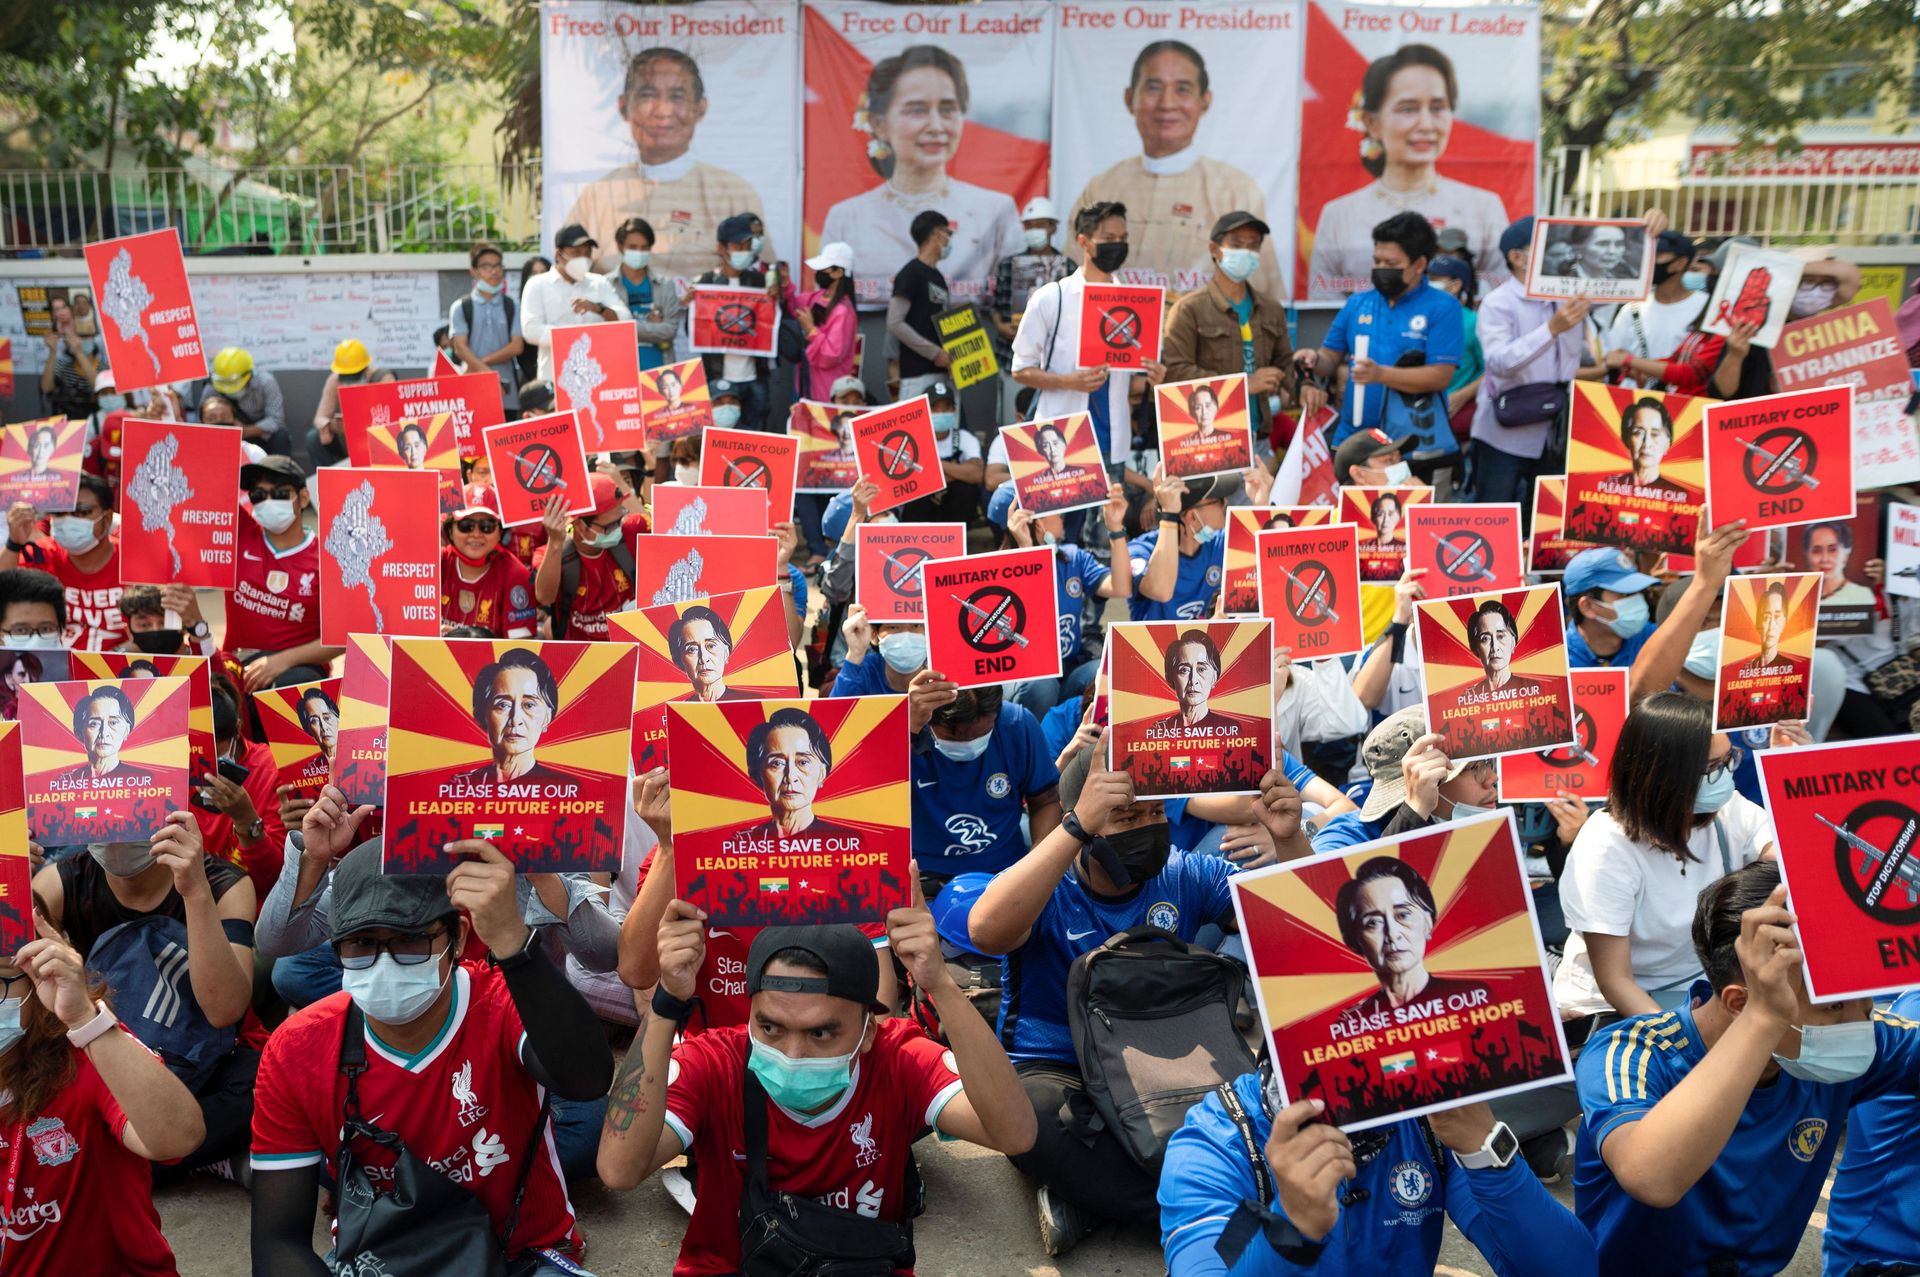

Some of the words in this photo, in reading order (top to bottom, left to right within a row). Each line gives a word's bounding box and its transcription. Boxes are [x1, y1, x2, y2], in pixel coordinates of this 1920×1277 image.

[551, 14, 604, 35] Free
[616, 15, 660, 35] Our
[671, 14, 785, 35] President
[843, 12, 896, 34] Free
[905, 12, 948, 34] Our
[959, 13, 1042, 34] Leader
[1061, 8, 1124, 30] Free
[1136, 8, 1173, 29] Our
[1180, 9, 1292, 30] President
[1344, 11, 1391, 32] Free
[1400, 11, 1441, 33] Our
[1450, 12, 1527, 35] Leader
[1089, 294, 1128, 303] MILITARY
[1130, 296, 1157, 304] COUP
[149, 306, 192, 326] #RESPECT
[177, 325, 196, 340] OUR
[1784, 311, 1880, 357] CHINA
[172, 341, 200, 359] VOTES
[951, 335, 986, 361] MILITARY
[1105, 352, 1132, 363] END
[1779, 336, 1900, 386] TYRANNIZE
[397, 382, 439, 399] SUPPORT
[600, 387, 638, 401] #RESPECT
[404, 398, 466, 417] MYANMAR
[623, 403, 640, 415] OUR
[616, 418, 641, 431] VOTES
[859, 418, 897, 438] MILITARY
[899, 409, 923, 425] COUP
[1719, 410, 1792, 431] MILITARY
[1794, 402, 1840, 420] COUP
[494, 429, 538, 448] MILITARY
[540, 424, 569, 438] COUP
[1202, 436, 1217, 444] SAVE
[712, 439, 757, 453] MILITARY
[761, 445, 790, 455] COUP
[1055, 471, 1070, 480] SAVE
[893, 480, 918, 498] END
[1024, 483, 1050, 493] LEADER
[1597, 480, 1633, 495] PLEASE
[1634, 484, 1663, 498] SAVE
[1664, 490, 1687, 503] OUR
[1579, 490, 1620, 506] LEADER
[1625, 496, 1668, 512] FUTURE
[1759, 497, 1804, 518] END
[182, 509, 234, 526] #RESPECT
[1418, 516, 1470, 527] MILITARY
[1474, 517, 1510, 527] COUP
[212, 531, 233, 545] OUR
[867, 535, 917, 544] MILITARY
[922, 535, 955, 544] COUP
[201, 550, 232, 564] VOTES
[1267, 543, 1316, 558] MILITARY
[1319, 541, 1349, 554] COUP
[382, 562, 435, 578] #RESPECT
[935, 570, 998, 587] MILITARY
[1002, 563, 1043, 579] COUP
[1233, 579, 1258, 588] LEADE
[64, 587, 124, 608] EVER
[238, 581, 289, 610] Standard
[414, 585, 436, 600] OUR
[233, 591, 286, 620] Chartered
[402, 605, 436, 620] VOTES
[973, 629, 985, 643] STOP
[984, 595, 1012, 631] DICTATORSHIP
[1298, 631, 1330, 648] END
[975, 655, 1016, 675] END
[1739, 667, 1761, 679] PLEASE
[1761, 665, 1777, 677] SAVE
[1779, 664, 1793, 675] OUR
[1576, 683, 1617, 696] COUP
[1728, 679, 1753, 690] LEADER
[1755, 676, 1781, 688] FUTURE
[1784, 673, 1803, 685] HOPE
[1458, 692, 1490, 706] PLEASE
[1491, 688, 1518, 700] SAVE
[1519, 685, 1540, 697] OUR
[1443, 705, 1481, 720] LEADER
[1485, 700, 1524, 715] FUTURE
[1529, 694, 1558, 708] HOPE
[644, 730, 667, 742] LEA
[1146, 726, 1181, 739] PLEASE
[1184, 726, 1213, 738] SAVE
[1215, 725, 1239, 736] OUR
[1127, 741, 1170, 752] LEADER
[1176, 739, 1220, 750] FUTURE
[1226, 737, 1257, 748] HOPE
[351, 750, 388, 761] LEAD
[303, 764, 328, 777] PLEASE
[50, 778, 89, 792] PLEASE
[92, 777, 124, 788] SAVE
[126, 775, 152, 787] OUR
[293, 775, 324, 788] LEADER
[1544, 773, 1585, 789] END
[1784, 768, 1887, 799] MILITARY
[28, 791, 75, 805] LEADER
[83, 789, 131, 801] FUTURE
[138, 786, 172, 798] HOPE
[439, 784, 494, 798] PLEASE
[497, 783, 540, 798] SAVE
[544, 783, 577, 798] OUR
[409, 800, 475, 815] LEADER
[485, 800, 549, 815] FUTURE
[559, 800, 604, 814] HOPE
[722, 841, 775, 855] PLEASE
[779, 839, 821, 852] SAVE
[825, 837, 860, 851] OUR
[696, 856, 758, 870] LEADER
[768, 854, 832, 869] FUTURE
[843, 853, 889, 867] HOPE
[1866, 880, 1883, 907] STOP
[1879, 818, 1917, 881] DICTATORSHIP
[1151, 905, 1170, 918] CHELSEA
[1877, 936, 1920, 969] EN
[1330, 1013, 1391, 1040] PLEASE
[1394, 999, 1446, 1025] SAVE
[1447, 988, 1488, 1010] OUR
[1303, 1038, 1377, 1066] LEADER
[1386, 1016, 1461, 1046] FUTURE
[1471, 999, 1526, 1025] HOPE
[458, 1107, 489, 1128] L.F.C.
[856, 1151, 882, 1168] L.F.C.
